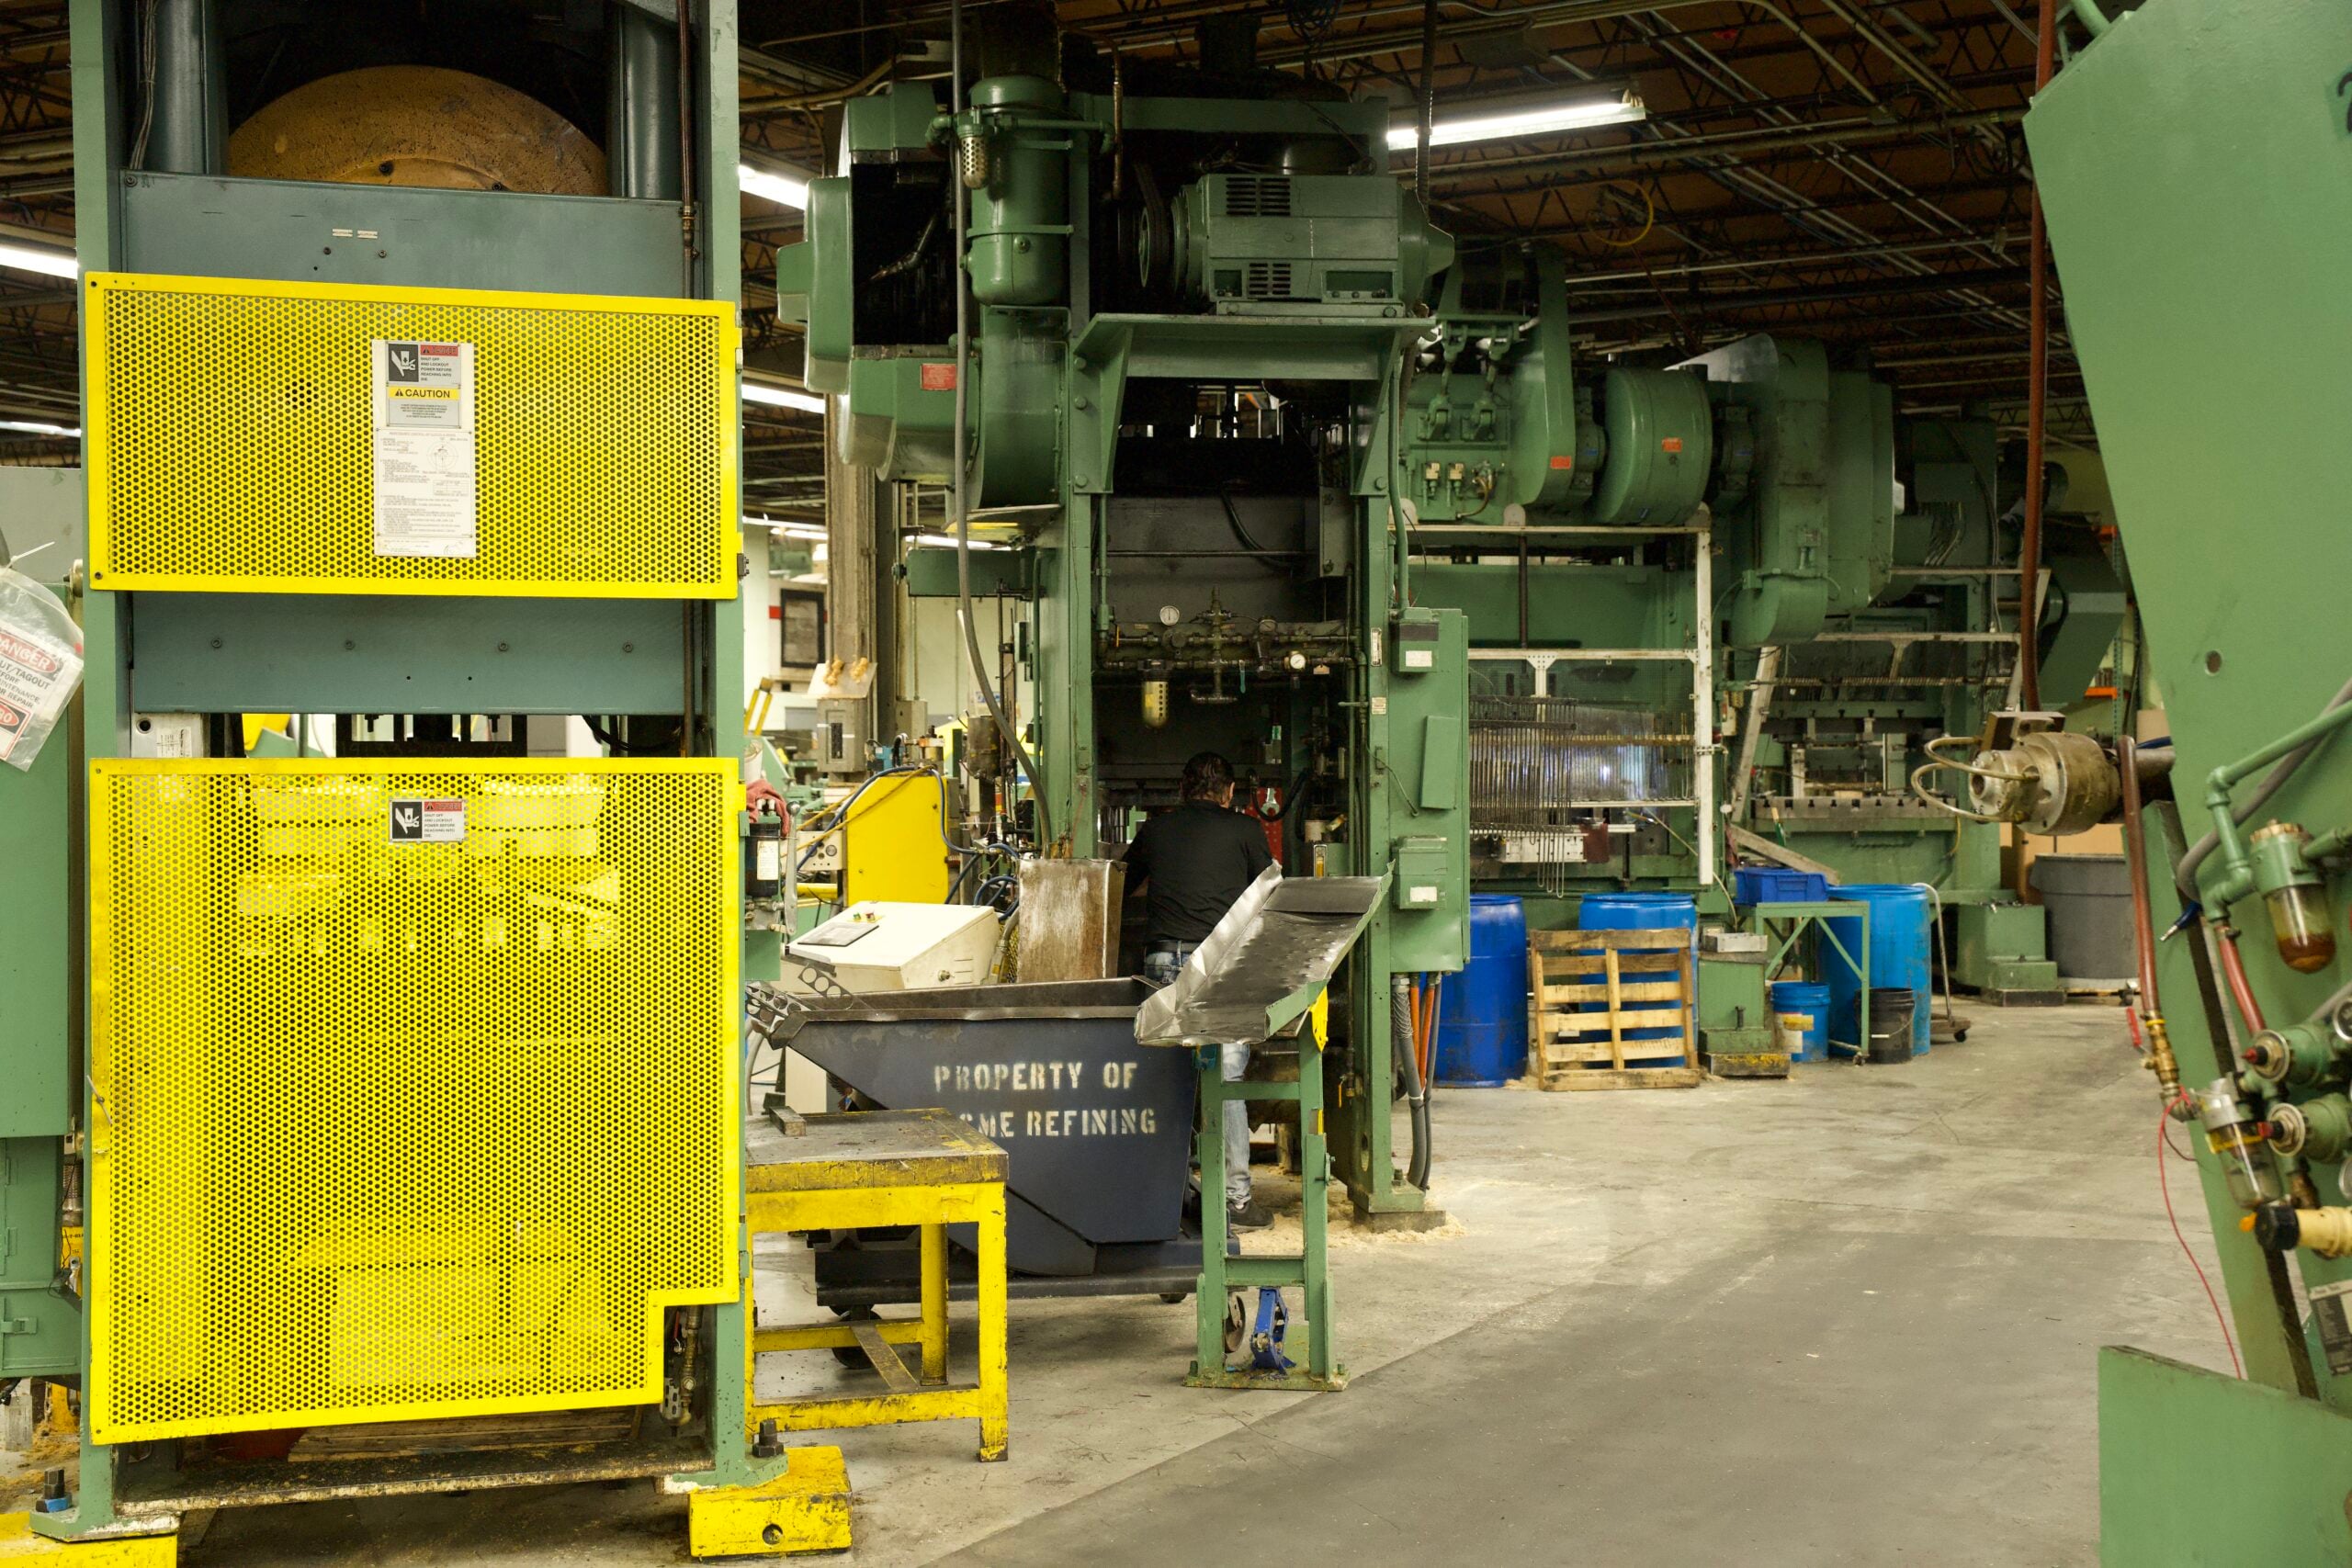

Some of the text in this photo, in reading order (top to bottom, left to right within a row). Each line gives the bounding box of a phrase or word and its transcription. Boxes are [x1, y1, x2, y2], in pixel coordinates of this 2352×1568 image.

[405, 389, 450, 398] CAUTION
[0, 635, 51, 670] ANGER
[7, 692, 34, 708] REPAIR
[933, 1061, 1138, 1093] PROPERTY OF
[959, 1108, 1157, 1138] ME REFINING
